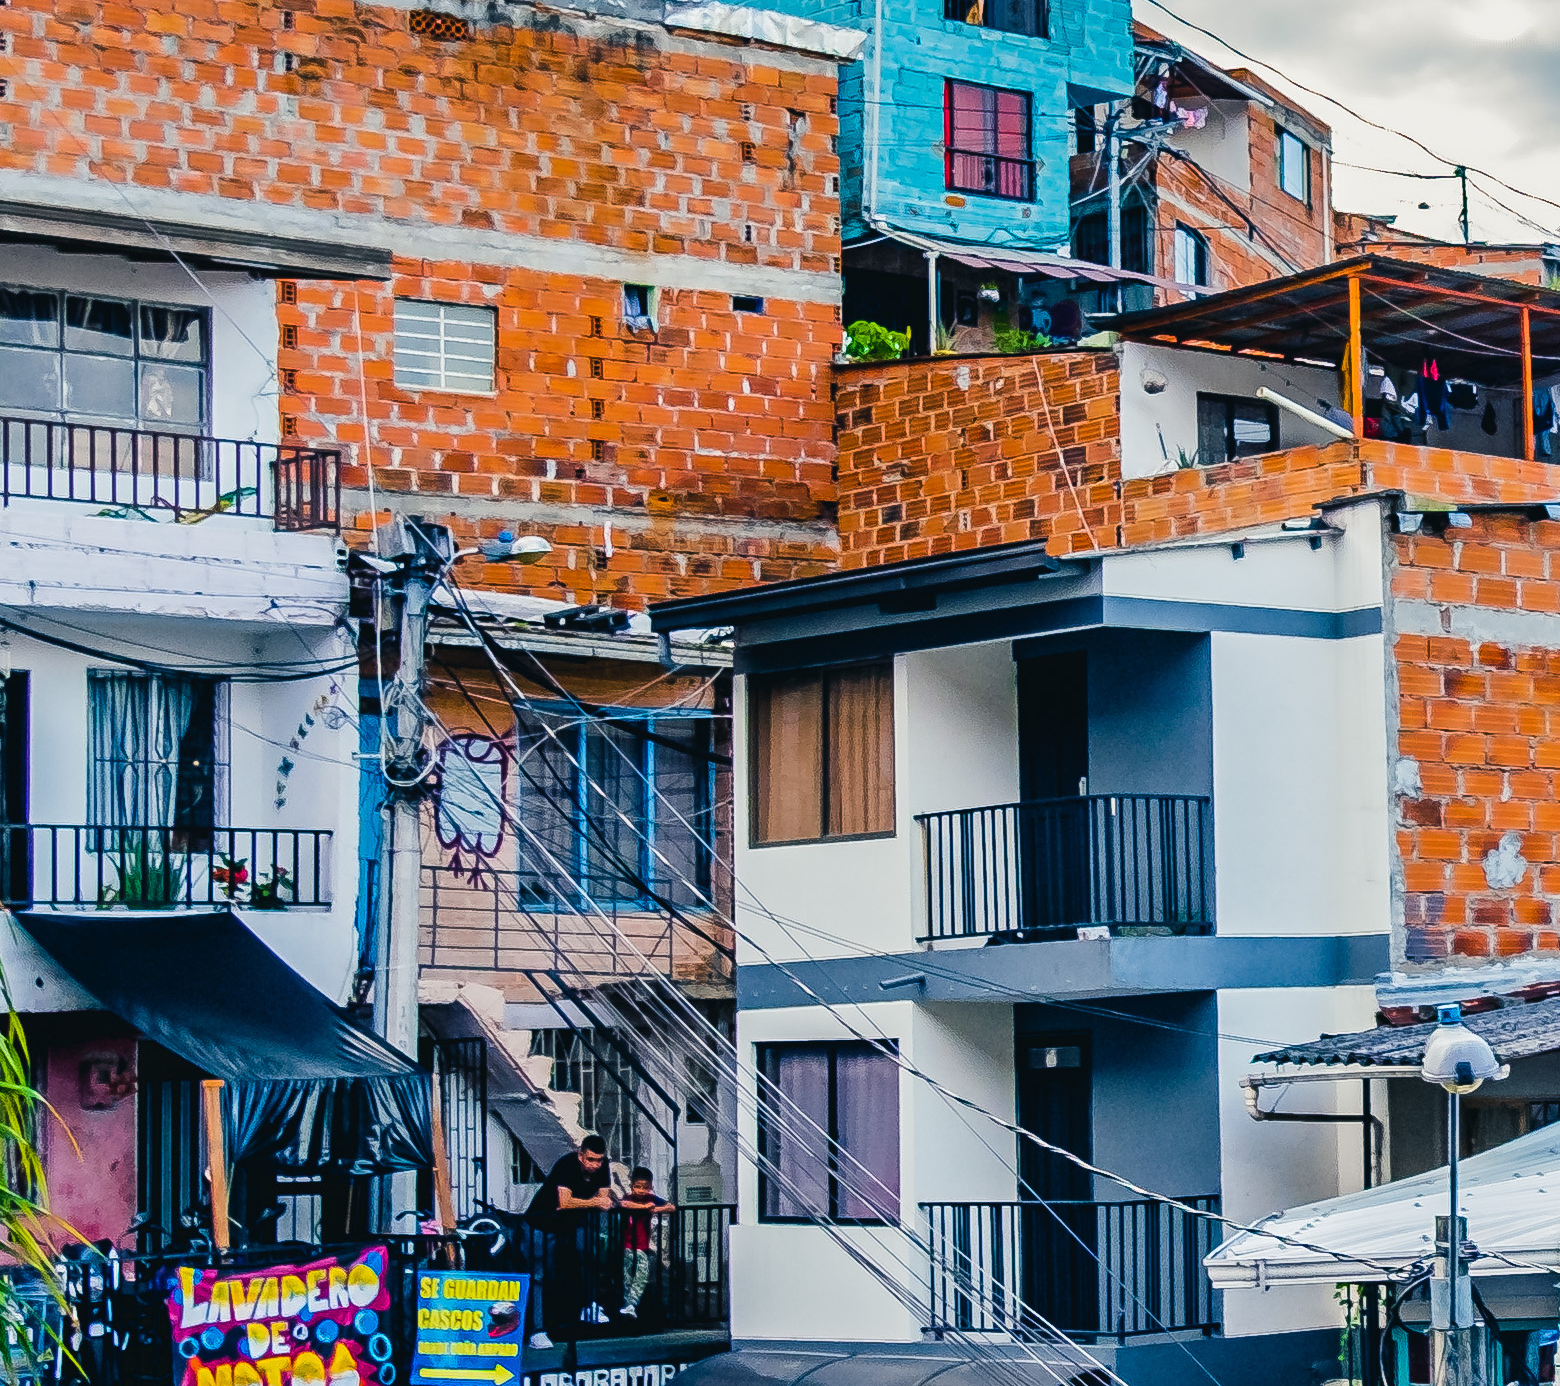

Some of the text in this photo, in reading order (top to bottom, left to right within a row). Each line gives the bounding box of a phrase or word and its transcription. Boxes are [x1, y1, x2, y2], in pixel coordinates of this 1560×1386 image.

[178, 1263, 380, 1329] LAVADERO
[420, 1277, 521, 1302] SE GUARDAN
[417, 1308, 484, 1332] CASCOS
[246, 1321, 291, 1359] DE
